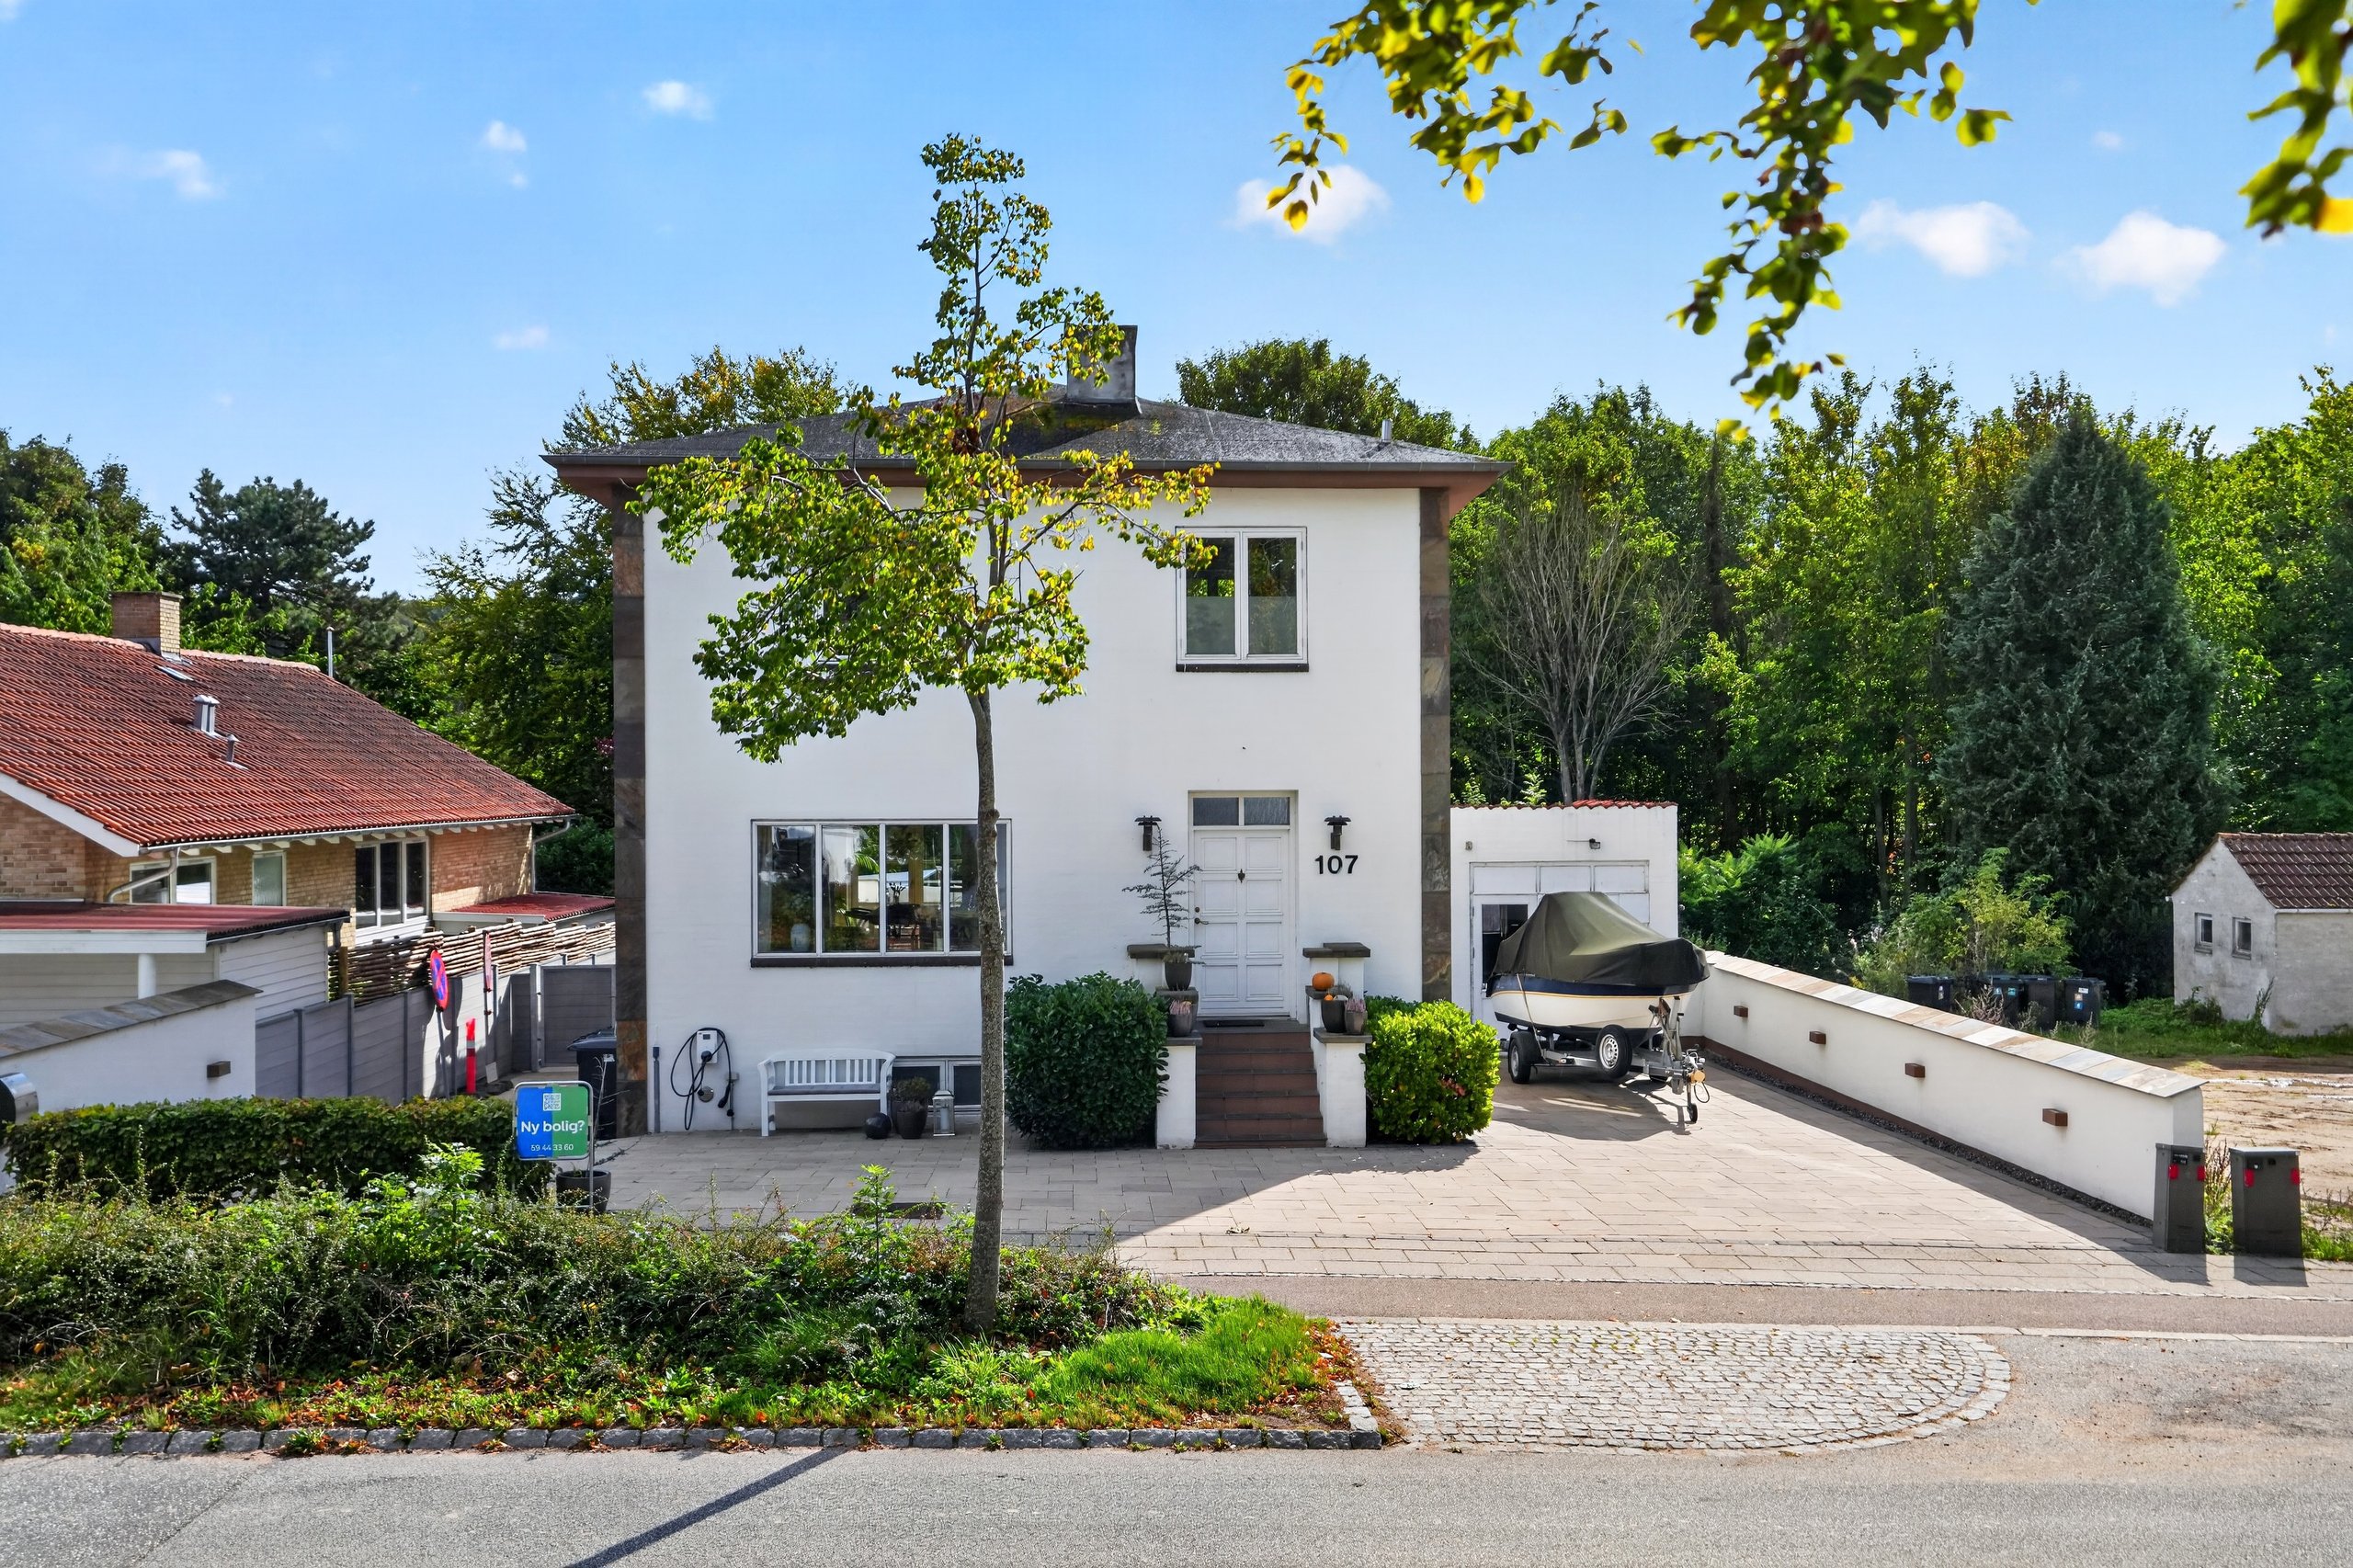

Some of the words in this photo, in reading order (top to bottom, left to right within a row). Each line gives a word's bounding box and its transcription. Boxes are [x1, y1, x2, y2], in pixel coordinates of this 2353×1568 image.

[1314, 855, 1358, 874] 107
[520, 1121, 540, 1134] Ny
[542, 1119, 585, 1134] bolig?
